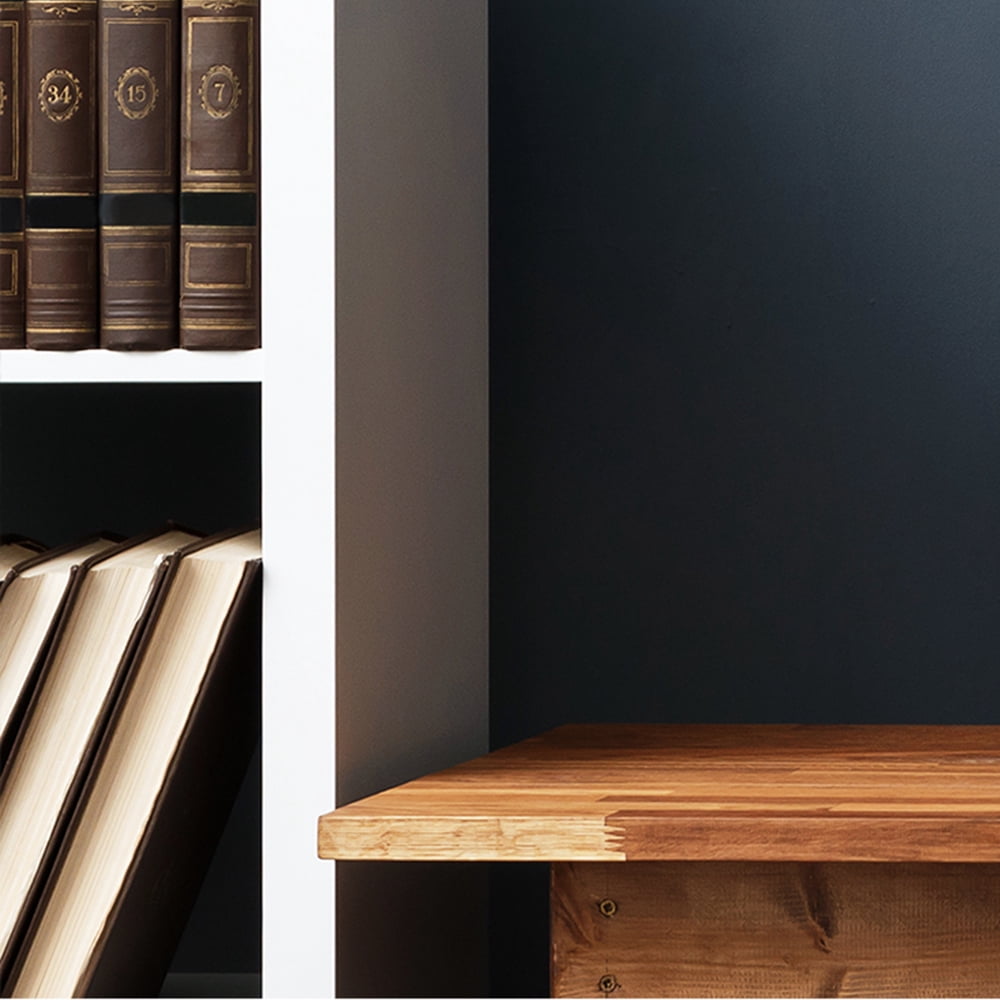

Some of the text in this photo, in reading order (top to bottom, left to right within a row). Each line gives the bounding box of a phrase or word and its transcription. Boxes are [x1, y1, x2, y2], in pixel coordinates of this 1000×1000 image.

[48, 85, 72, 104] 34
[127, 85, 146, 103] 15
[213, 83, 225, 102] 7
